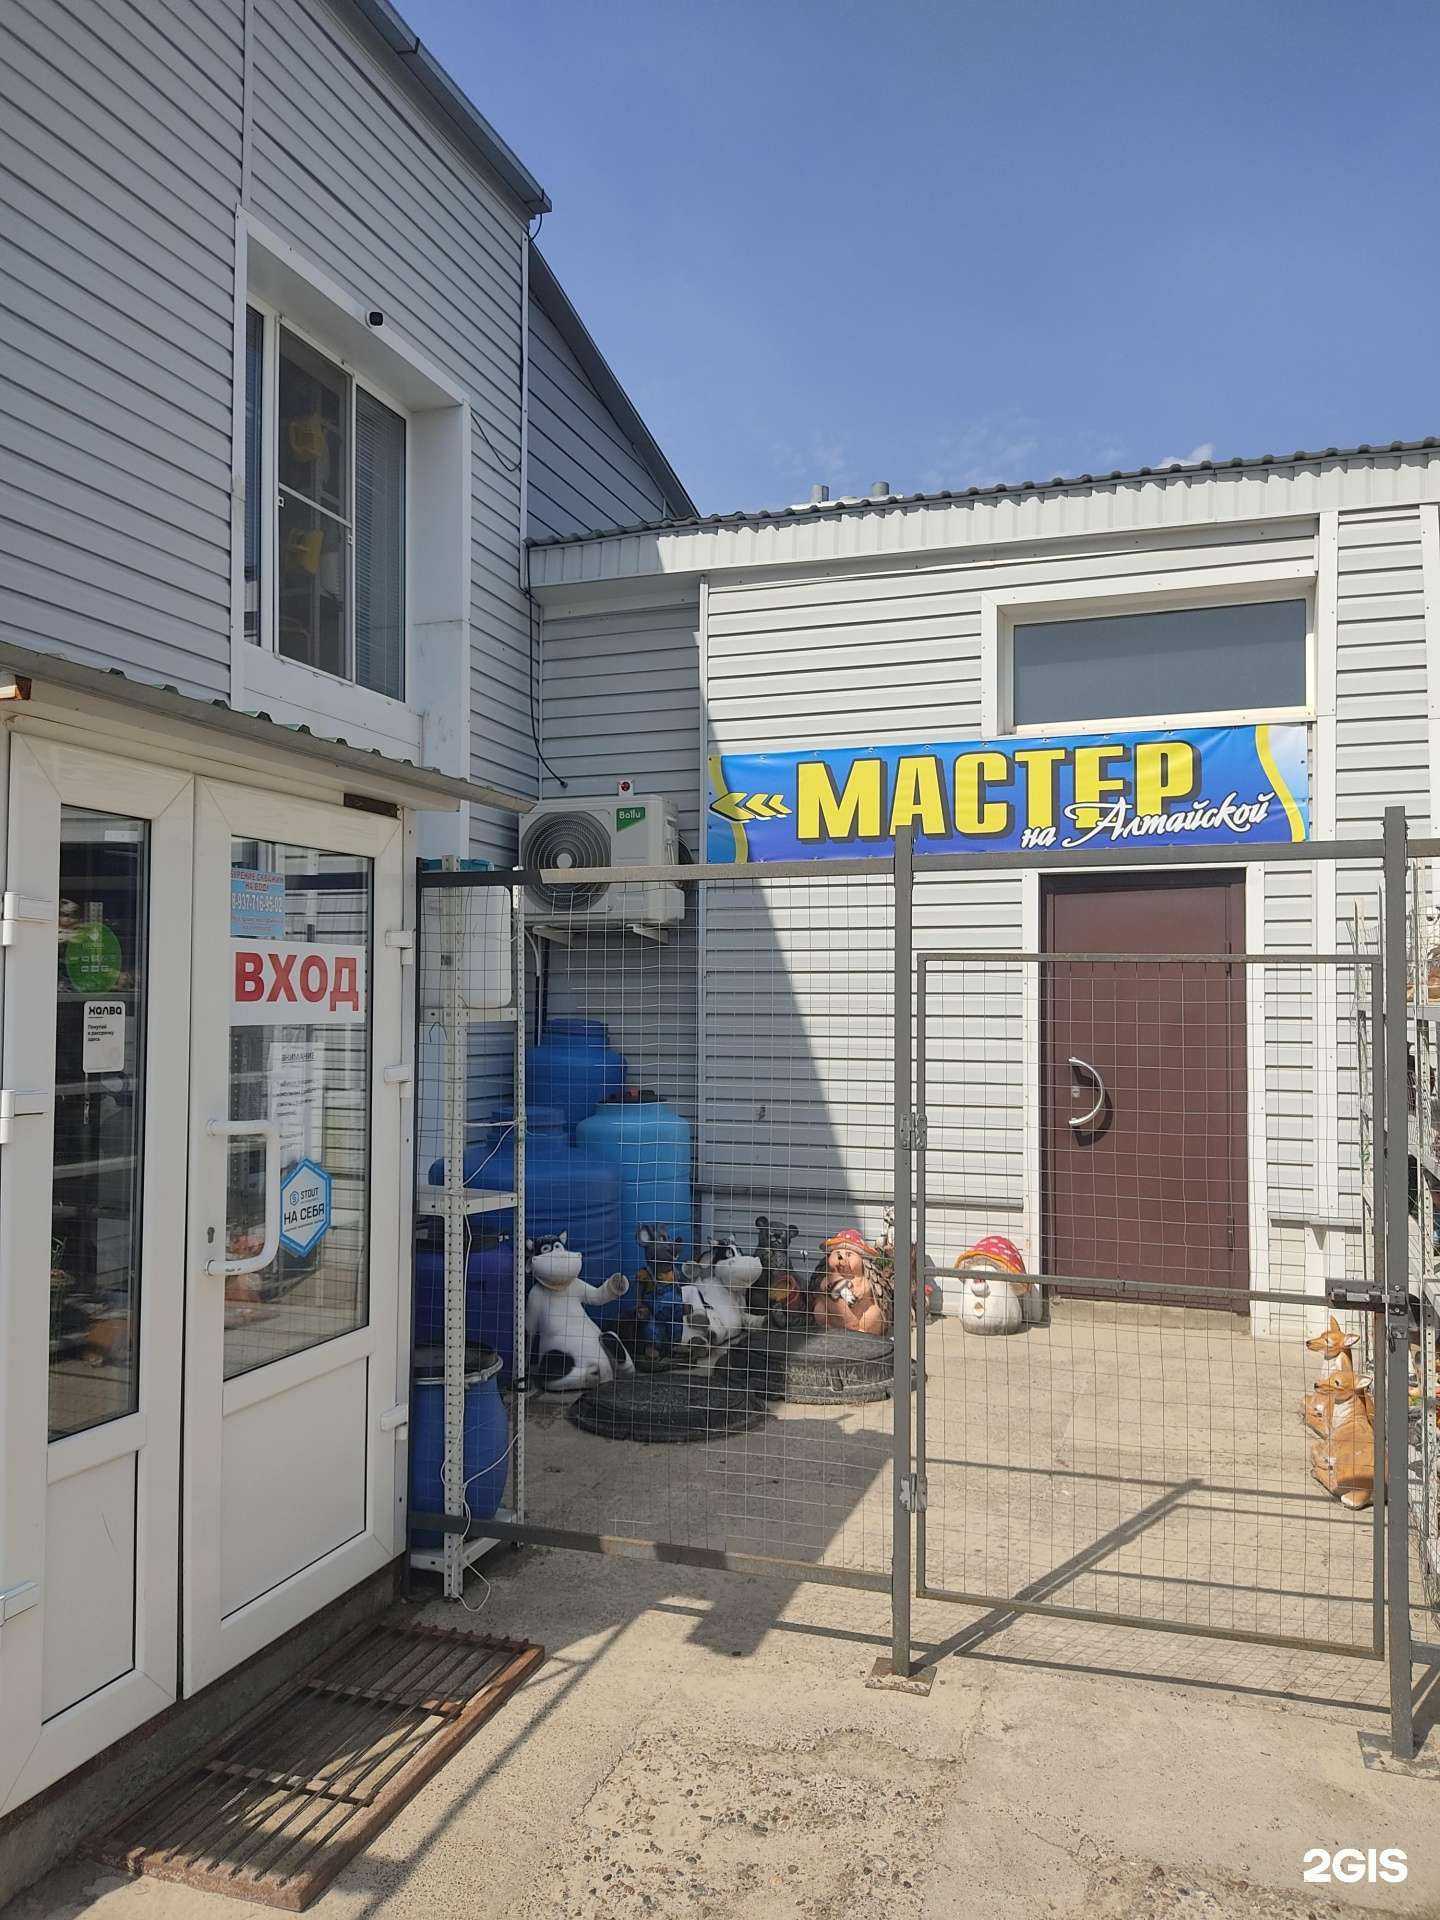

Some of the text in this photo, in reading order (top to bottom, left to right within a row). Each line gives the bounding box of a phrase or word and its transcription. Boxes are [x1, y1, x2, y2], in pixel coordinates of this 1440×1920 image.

[619, 808, 641, 819] Ballu
[797, 742, 1198, 842] МАСТЕР
[1022, 792, 1275, 849] на Алтайской
[235, 952, 359, 1011] ВХОД
[284, 1203, 325, 1225] НА СЕБЯ
